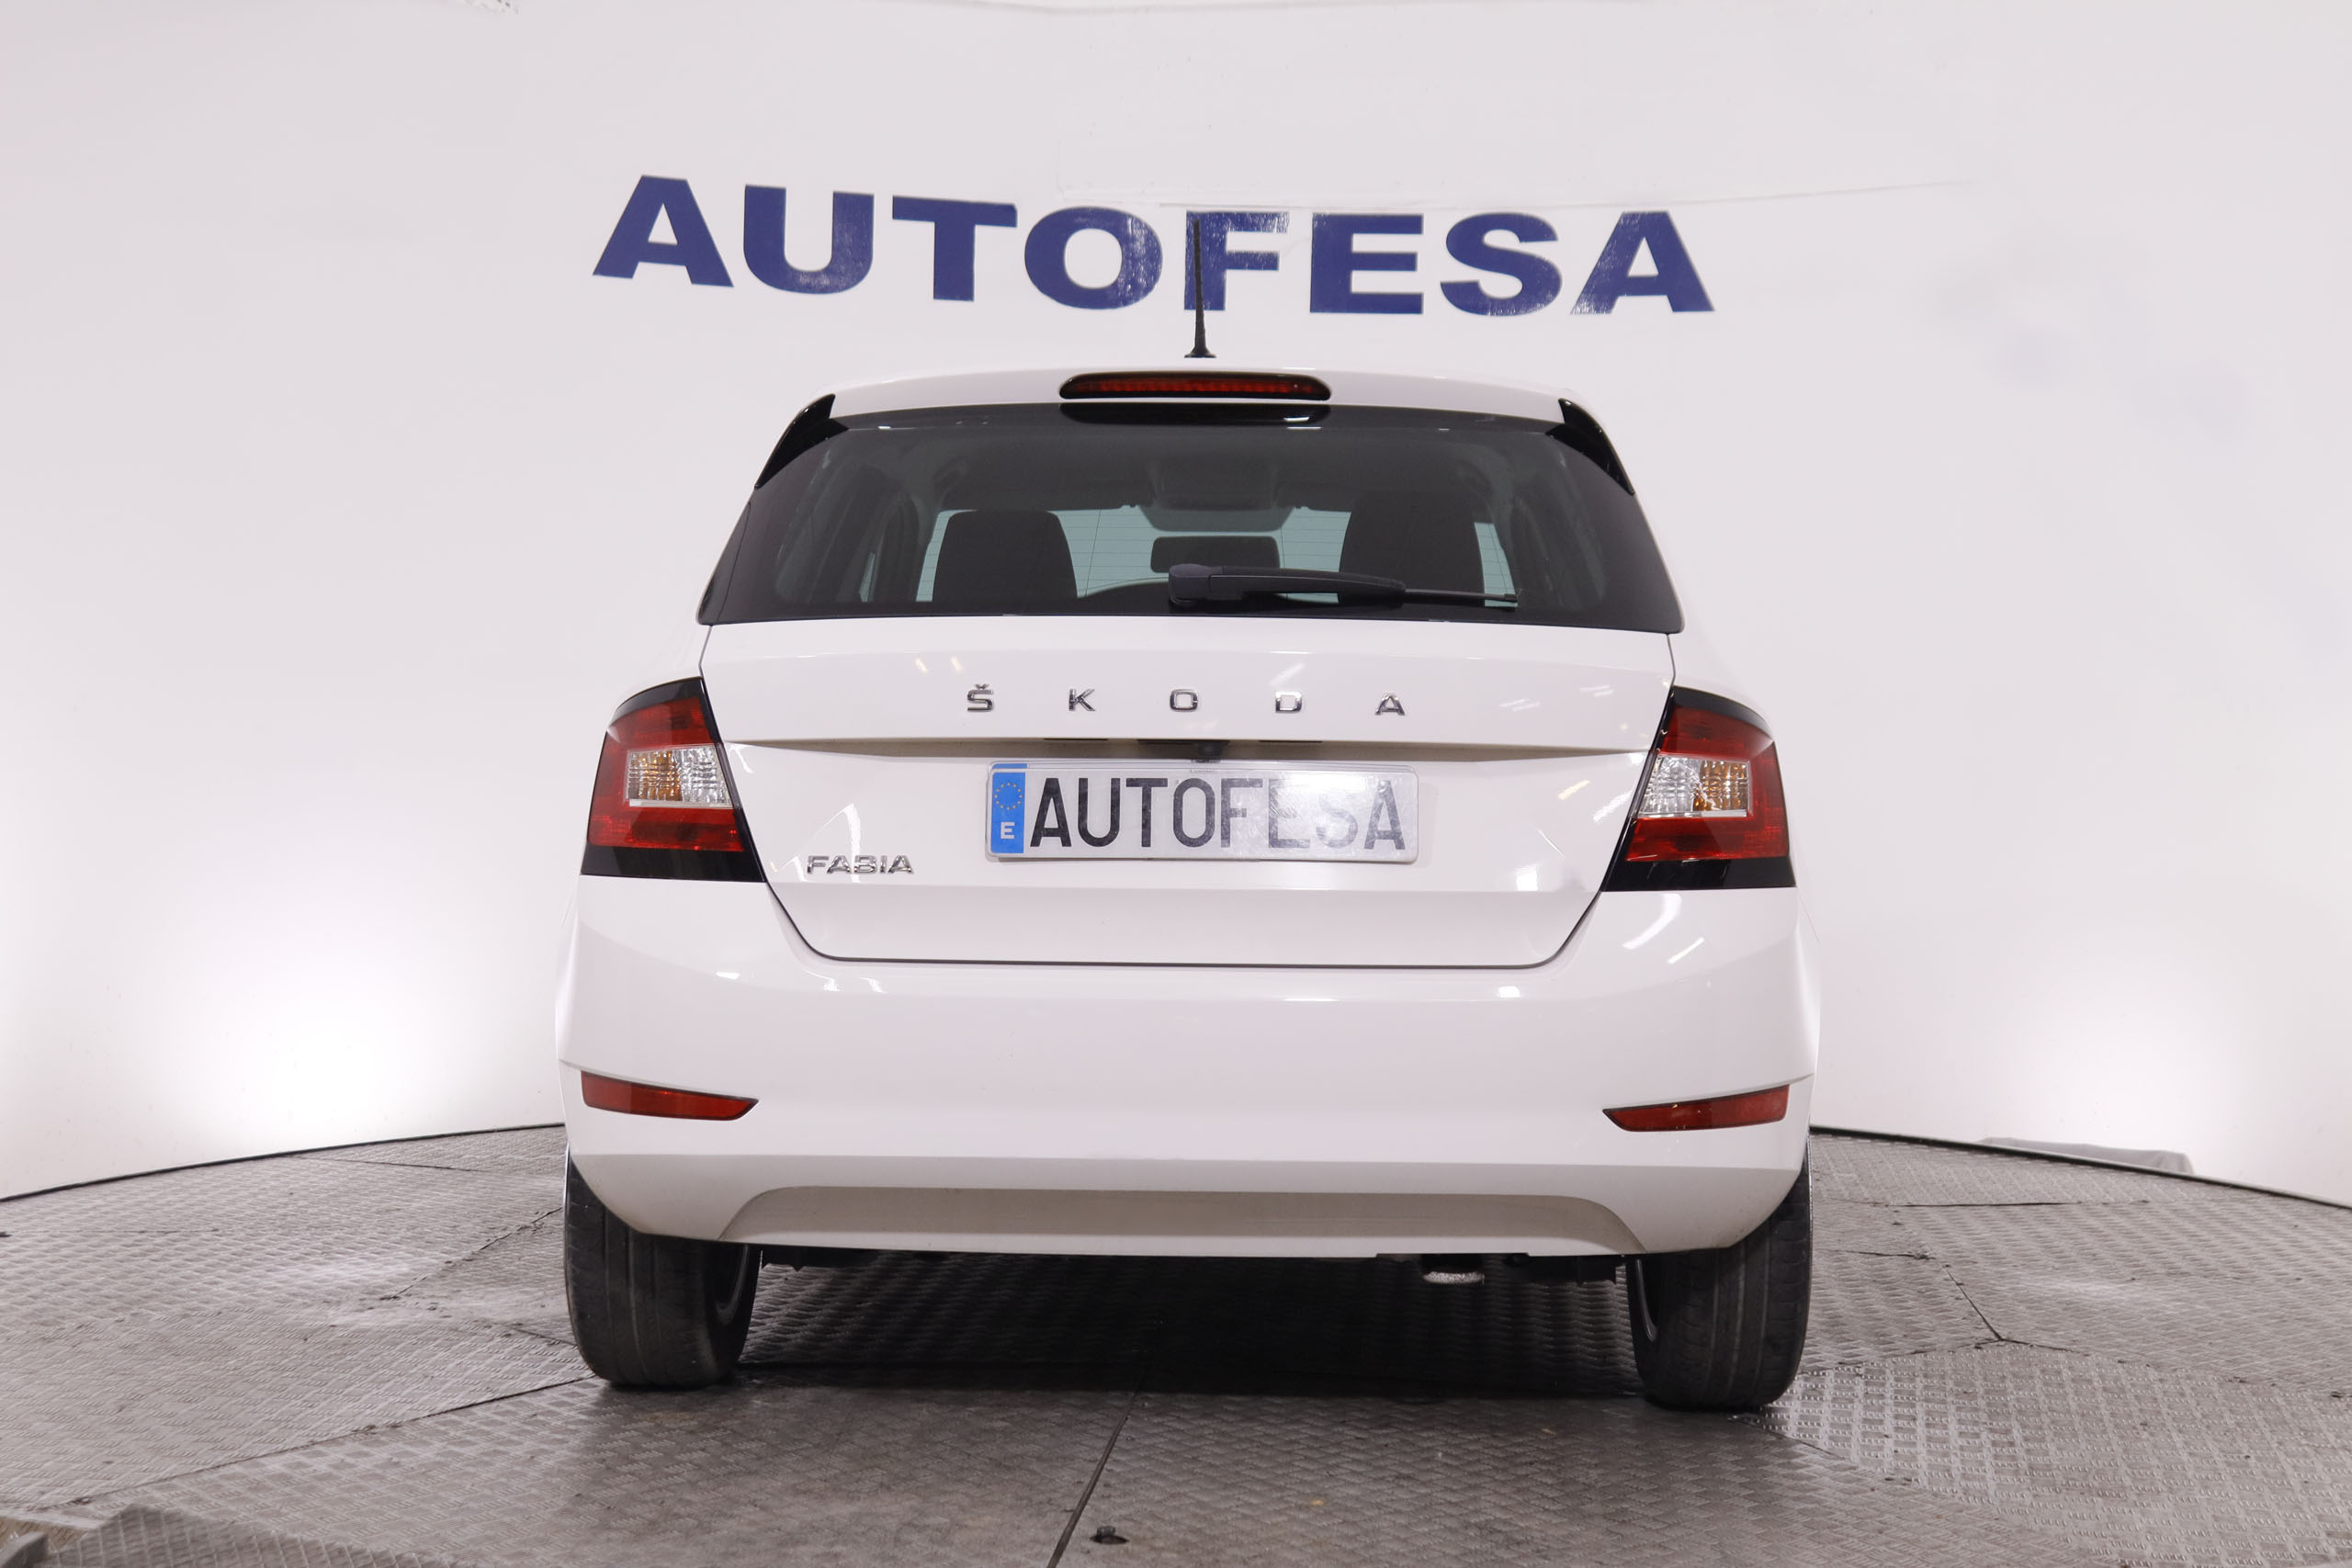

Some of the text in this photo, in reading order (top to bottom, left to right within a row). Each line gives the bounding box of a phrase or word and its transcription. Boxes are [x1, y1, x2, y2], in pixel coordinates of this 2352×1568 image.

[593, 175, 1715, 316] AUTOFESA
[967, 683, 1406, 716] ŠKODA
[1030, 776, 1407, 851] AUTOFESA
[1001, 821, 1015, 840] E
[807, 854, 914, 874] FABIA
